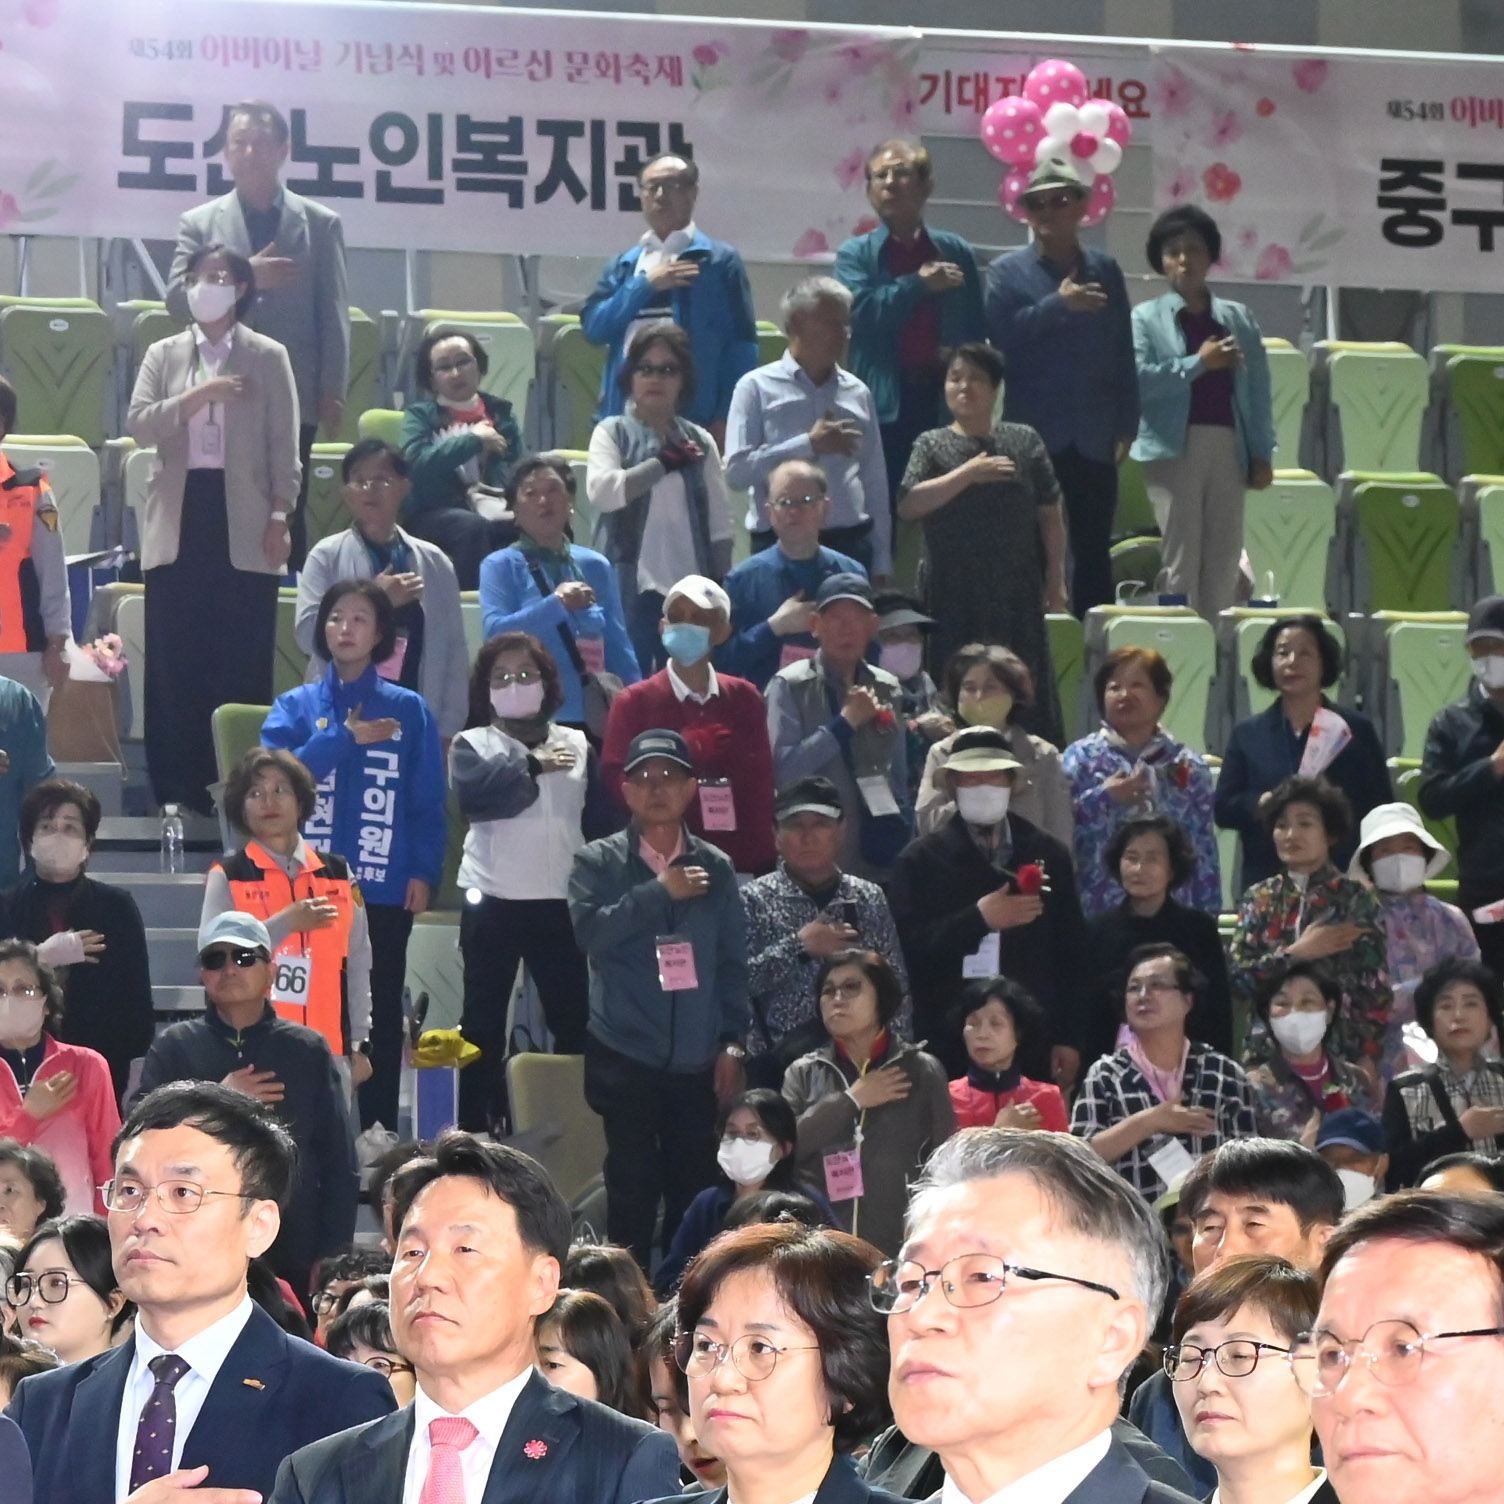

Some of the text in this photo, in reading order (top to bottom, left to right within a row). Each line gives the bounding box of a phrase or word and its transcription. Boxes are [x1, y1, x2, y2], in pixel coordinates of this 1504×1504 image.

[199, 35, 321, 72] 어버이날
[335, 40, 424, 77] 기념식
[463, 47, 553, 82] 어르신
[564, 51, 683, 87] 문화축제
[275, 963, 307, 994] 66
